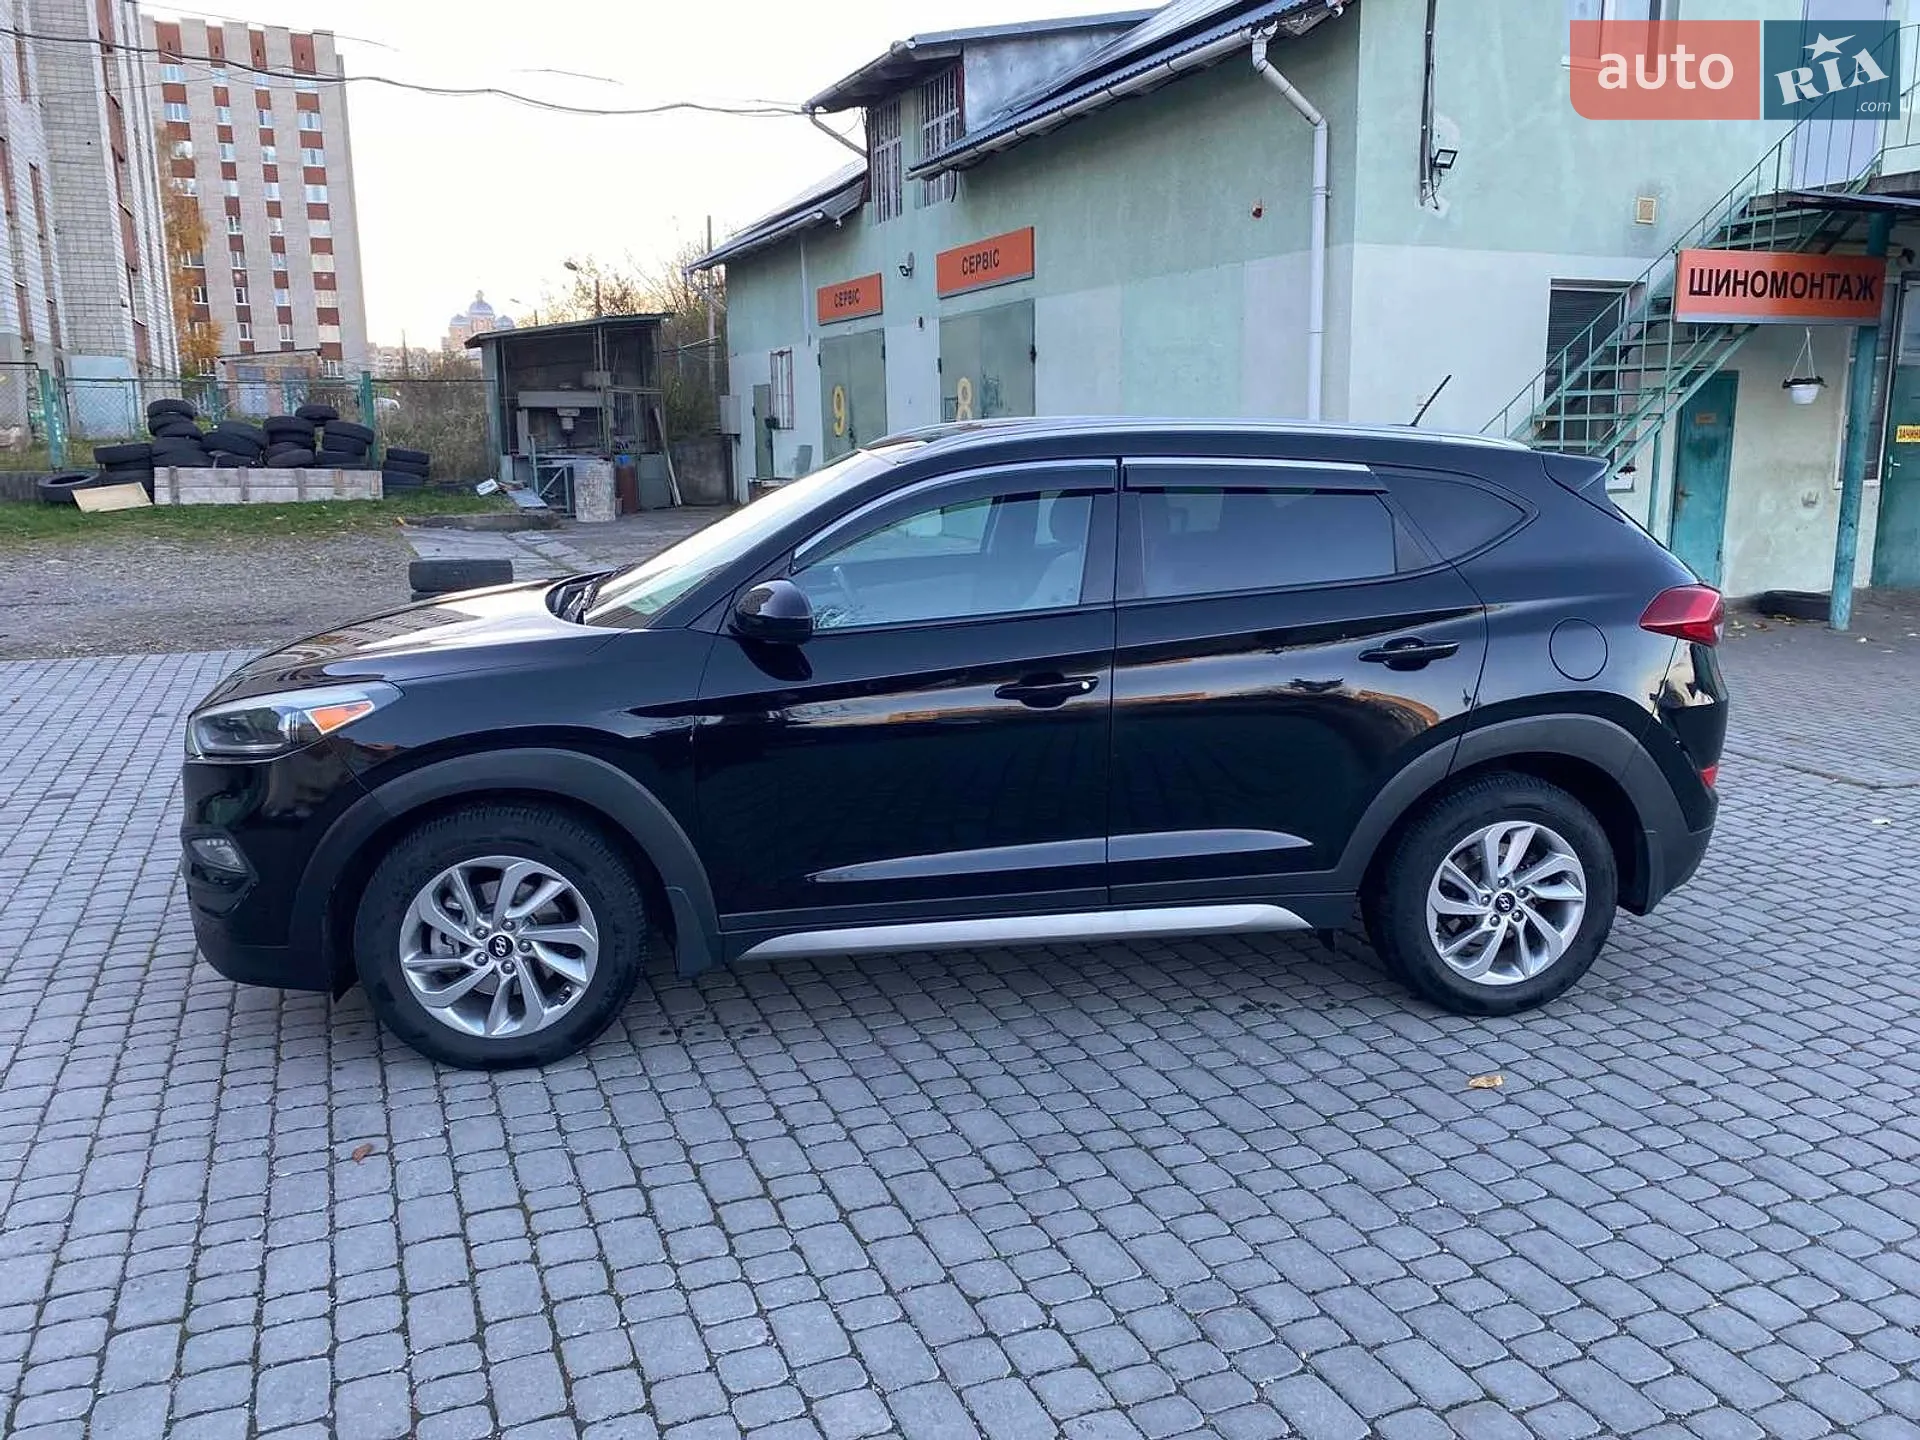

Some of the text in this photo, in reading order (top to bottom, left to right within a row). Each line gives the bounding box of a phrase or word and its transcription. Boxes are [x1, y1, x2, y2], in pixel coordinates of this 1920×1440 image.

[962, 248, 1000, 276] СЕРВІС
[834, 288, 860, 308] СЕРВІС
[1688, 268, 1878, 302] ШИНОМОНТАЖ
[832, 386, 845, 437] 9
